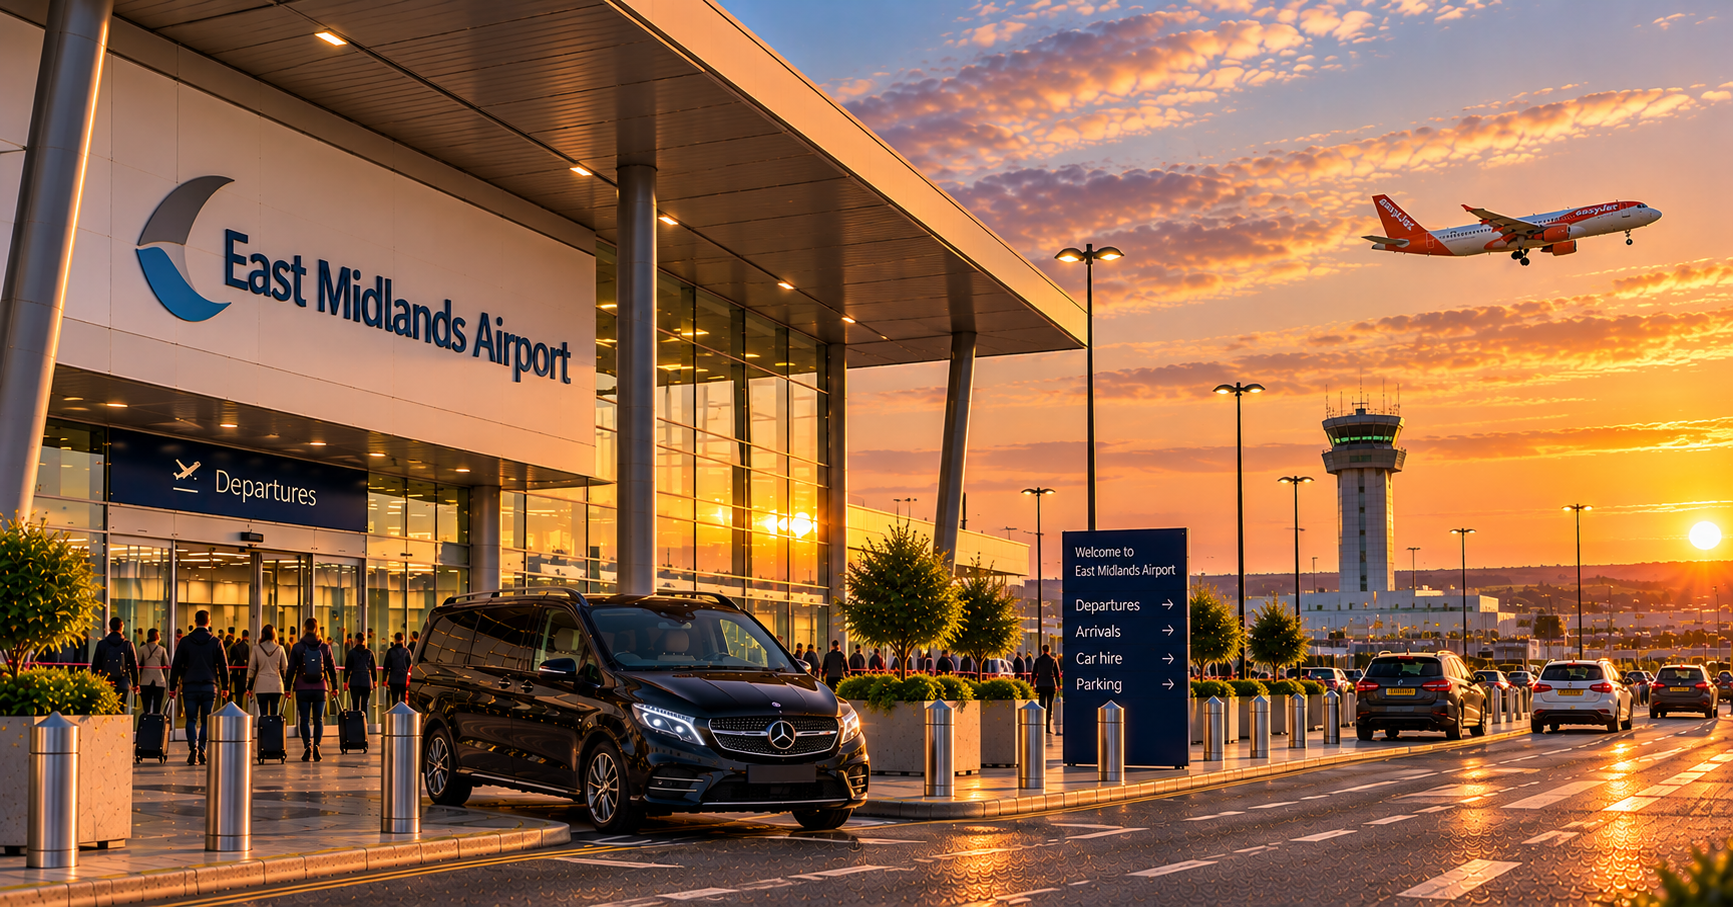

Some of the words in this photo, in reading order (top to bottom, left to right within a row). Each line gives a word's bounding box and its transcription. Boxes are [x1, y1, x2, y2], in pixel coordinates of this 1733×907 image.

[224, 228, 307, 308] East
[317, 258, 467, 354] Midlands
[472, 312, 572, 385] Airport
[215, 469, 317, 507] Departures
[1074, 546, 1121, 558] Welcome
[1123, 546, 1135, 558] to
[1075, 565, 1095, 577] East
[1097, 564, 1141, 577] Midlands
[1141, 563, 1176, 578] Airport
[1075, 598, 1141, 615] Departures
[1075, 624, 1121, 638] Arrivals
[1075, 652, 1097, 665] Car
[1099, 651, 1123, 665] hire
[1076, 677, 1123, 694] Parking
